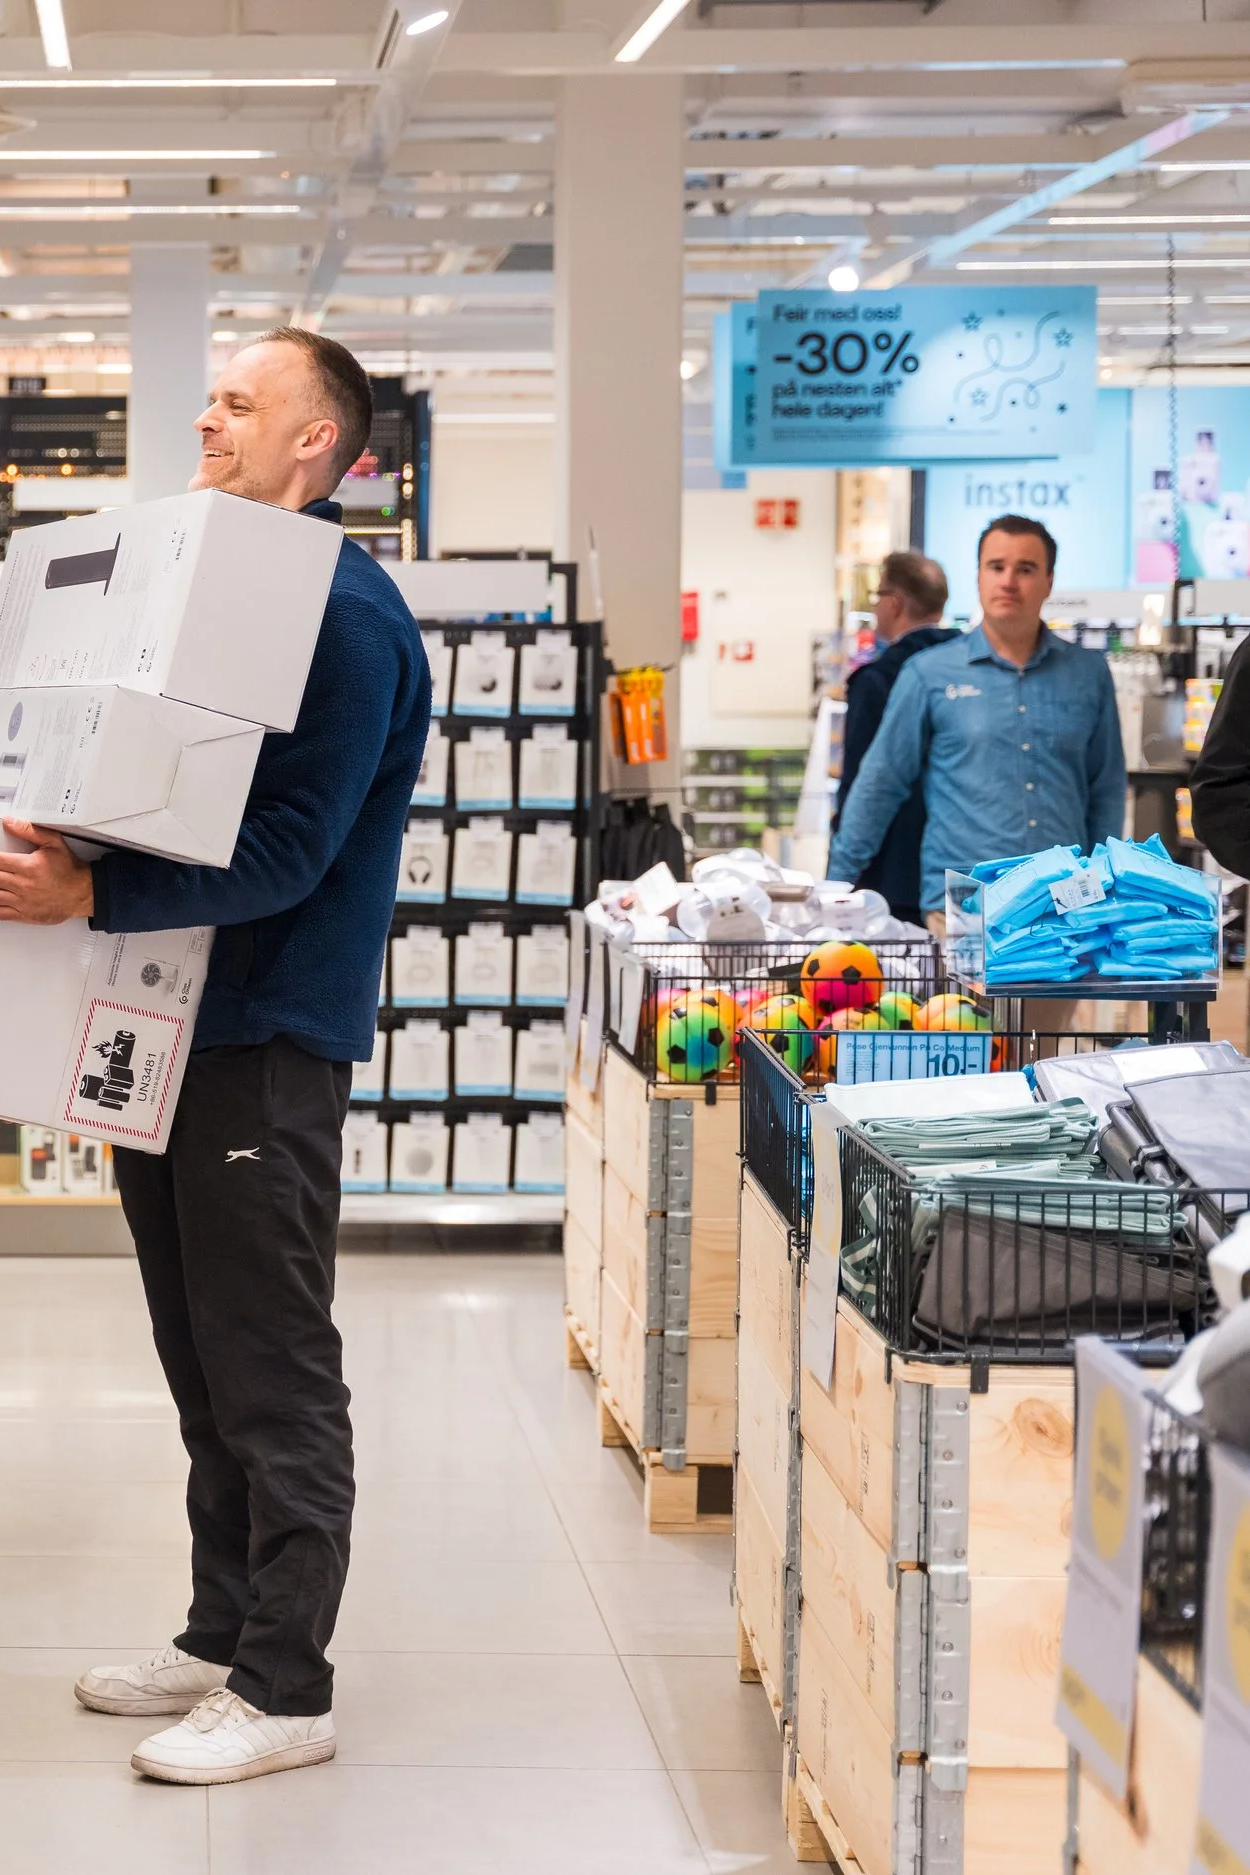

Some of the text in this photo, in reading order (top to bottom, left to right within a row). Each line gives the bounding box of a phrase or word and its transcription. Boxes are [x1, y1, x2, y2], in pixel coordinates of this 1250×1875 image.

[773, 304, 808, 322] Feir
[813, 304, 858, 322] med
[773, 329, 919, 375] -30%
[772, 379, 797, 399] på
[801, 380, 868, 398] nesten
[772, 400, 885, 422] hele dagen!
[965, 474, 1071, 507] instax
[137, 1052, 157, 1102] UN3481
